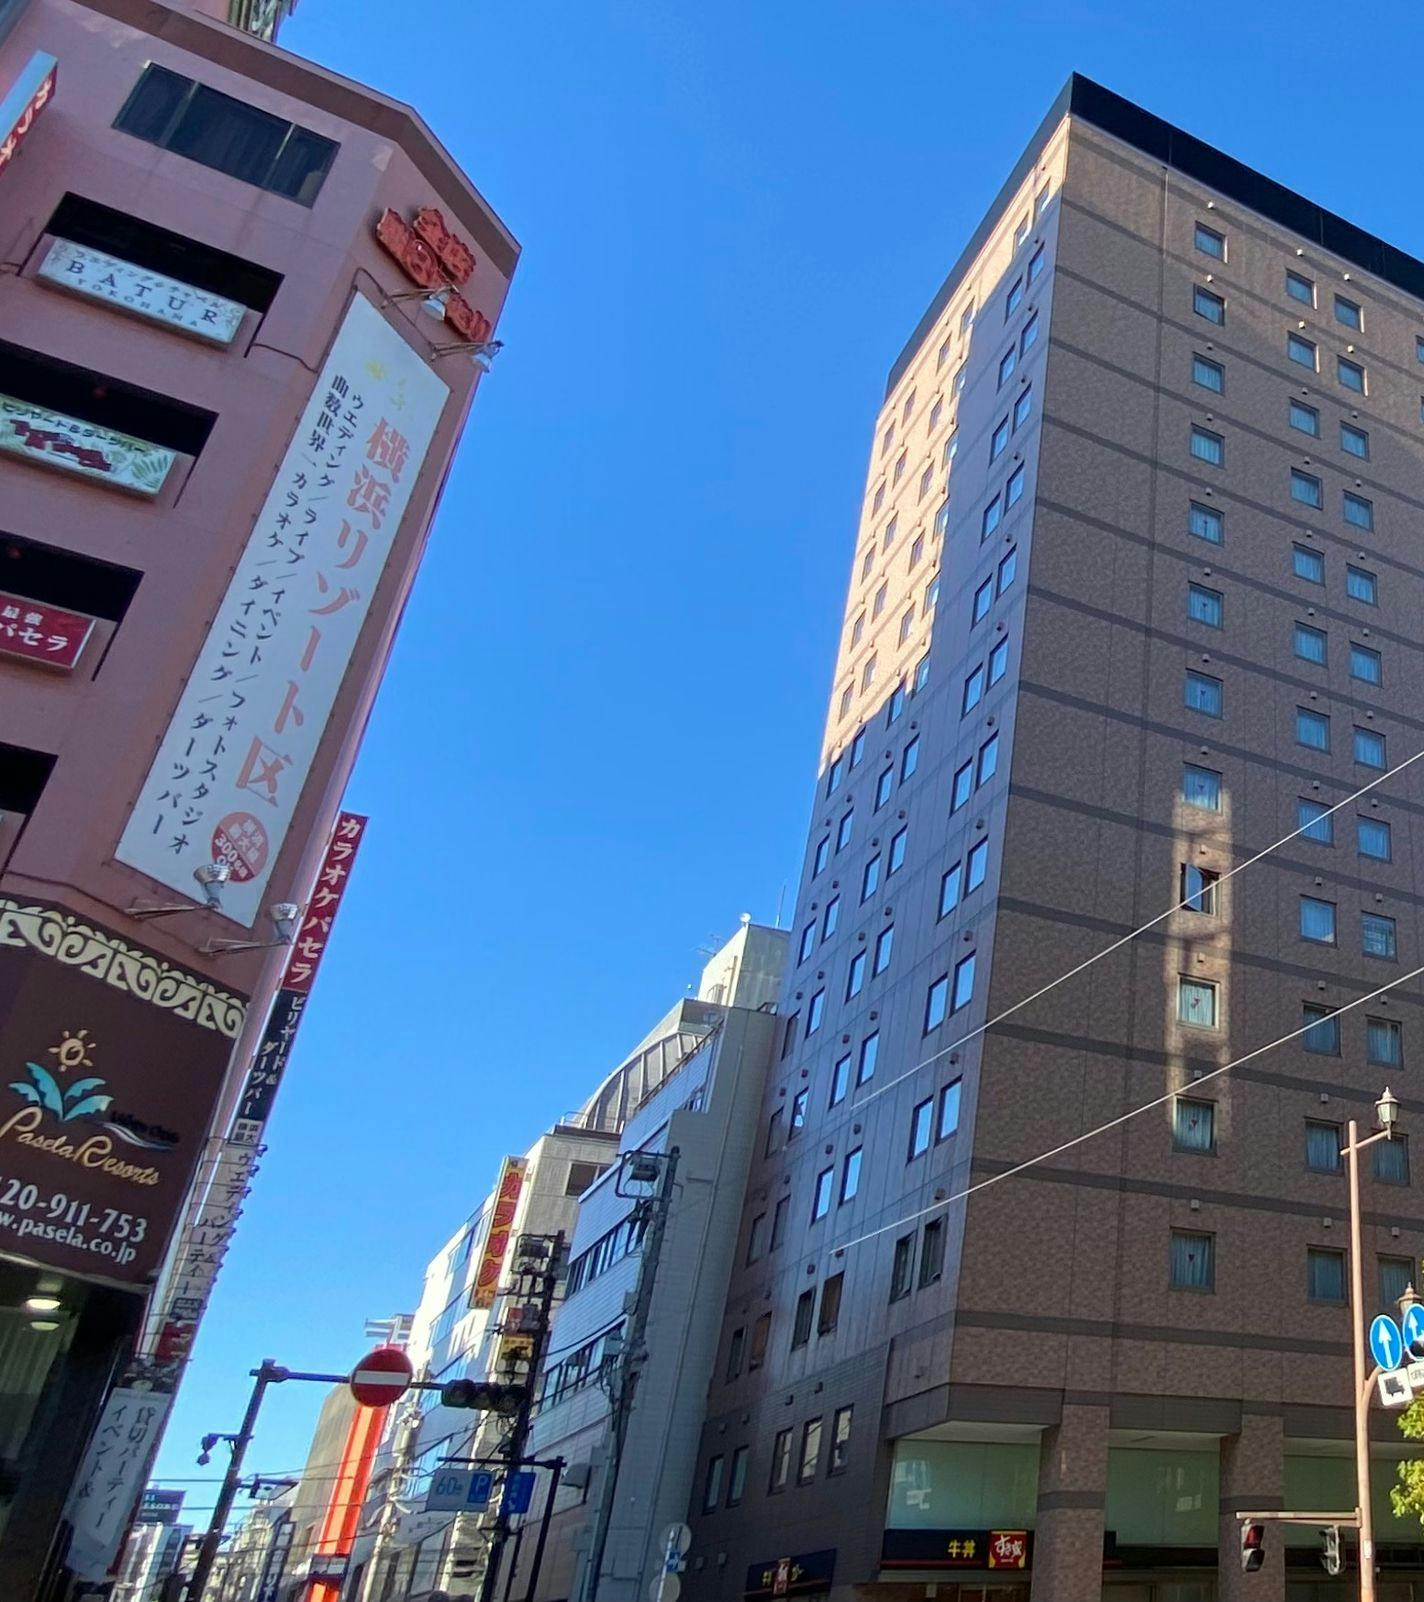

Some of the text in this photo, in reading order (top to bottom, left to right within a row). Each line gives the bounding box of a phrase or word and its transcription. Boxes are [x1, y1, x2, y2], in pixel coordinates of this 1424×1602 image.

[66, 260, 219, 325] BATUR
[78, 278, 199, 329] YOKOHAMA
[290, 818, 361, 984] カラオケパセラ
[72, 1135, 161, 1186] Resorts
[0, 1175, 149, 1243] 20-911-753
[947, 1540, 976, 1558] 牛丼
